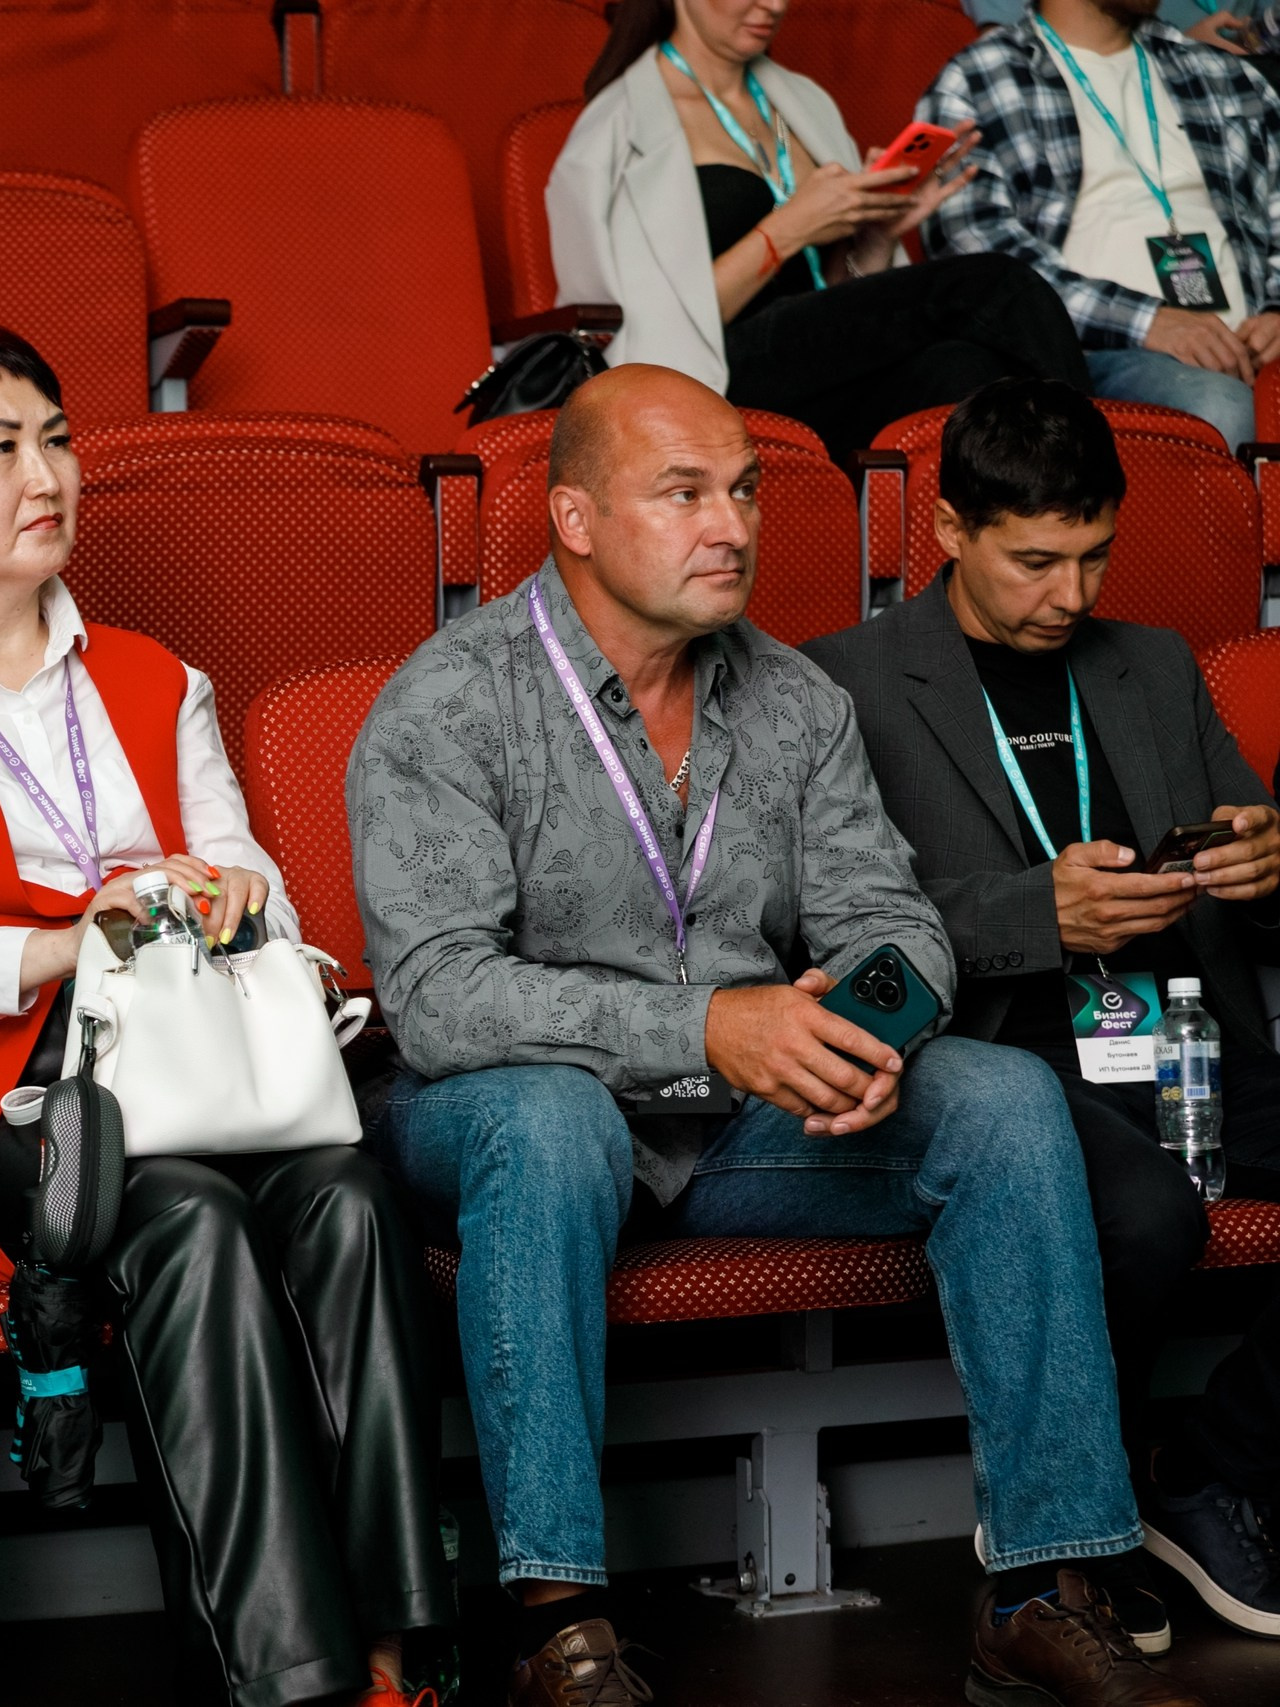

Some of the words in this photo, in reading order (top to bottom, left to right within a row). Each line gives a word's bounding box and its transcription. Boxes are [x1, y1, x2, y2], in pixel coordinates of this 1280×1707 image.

[532, 597, 549, 633] Бизнес
[546, 637, 561, 659] СБЕР
[566, 676, 584, 704] Фест
[581, 703, 604, 744] Бизнес
[70, 725, 82, 757] Бизнес
[1032, 732, 1073, 744] COUTURE
[1038, 742, 1055, 750] TOKYO
[75, 757, 87, 784] Фест
[602, 749, 618, 772] СБЕР
[20, 770, 40, 795] Фест
[37, 793, 64, 829] Бизнес
[85, 800, 93, 823] СБЕР
[623, 790, 639, 819] Фест
[63, 832, 82, 855] СБЕР
[636, 819, 658, 860] Бизнес
[698, 835, 707, 861] СБЕР
[655, 865, 670, 889] СБЕР
[1093, 1010, 1137, 1021] Бизнес
[1101, 1020, 1132, 1030] Фест
[1099, 1065, 1110, 1073] ИП
